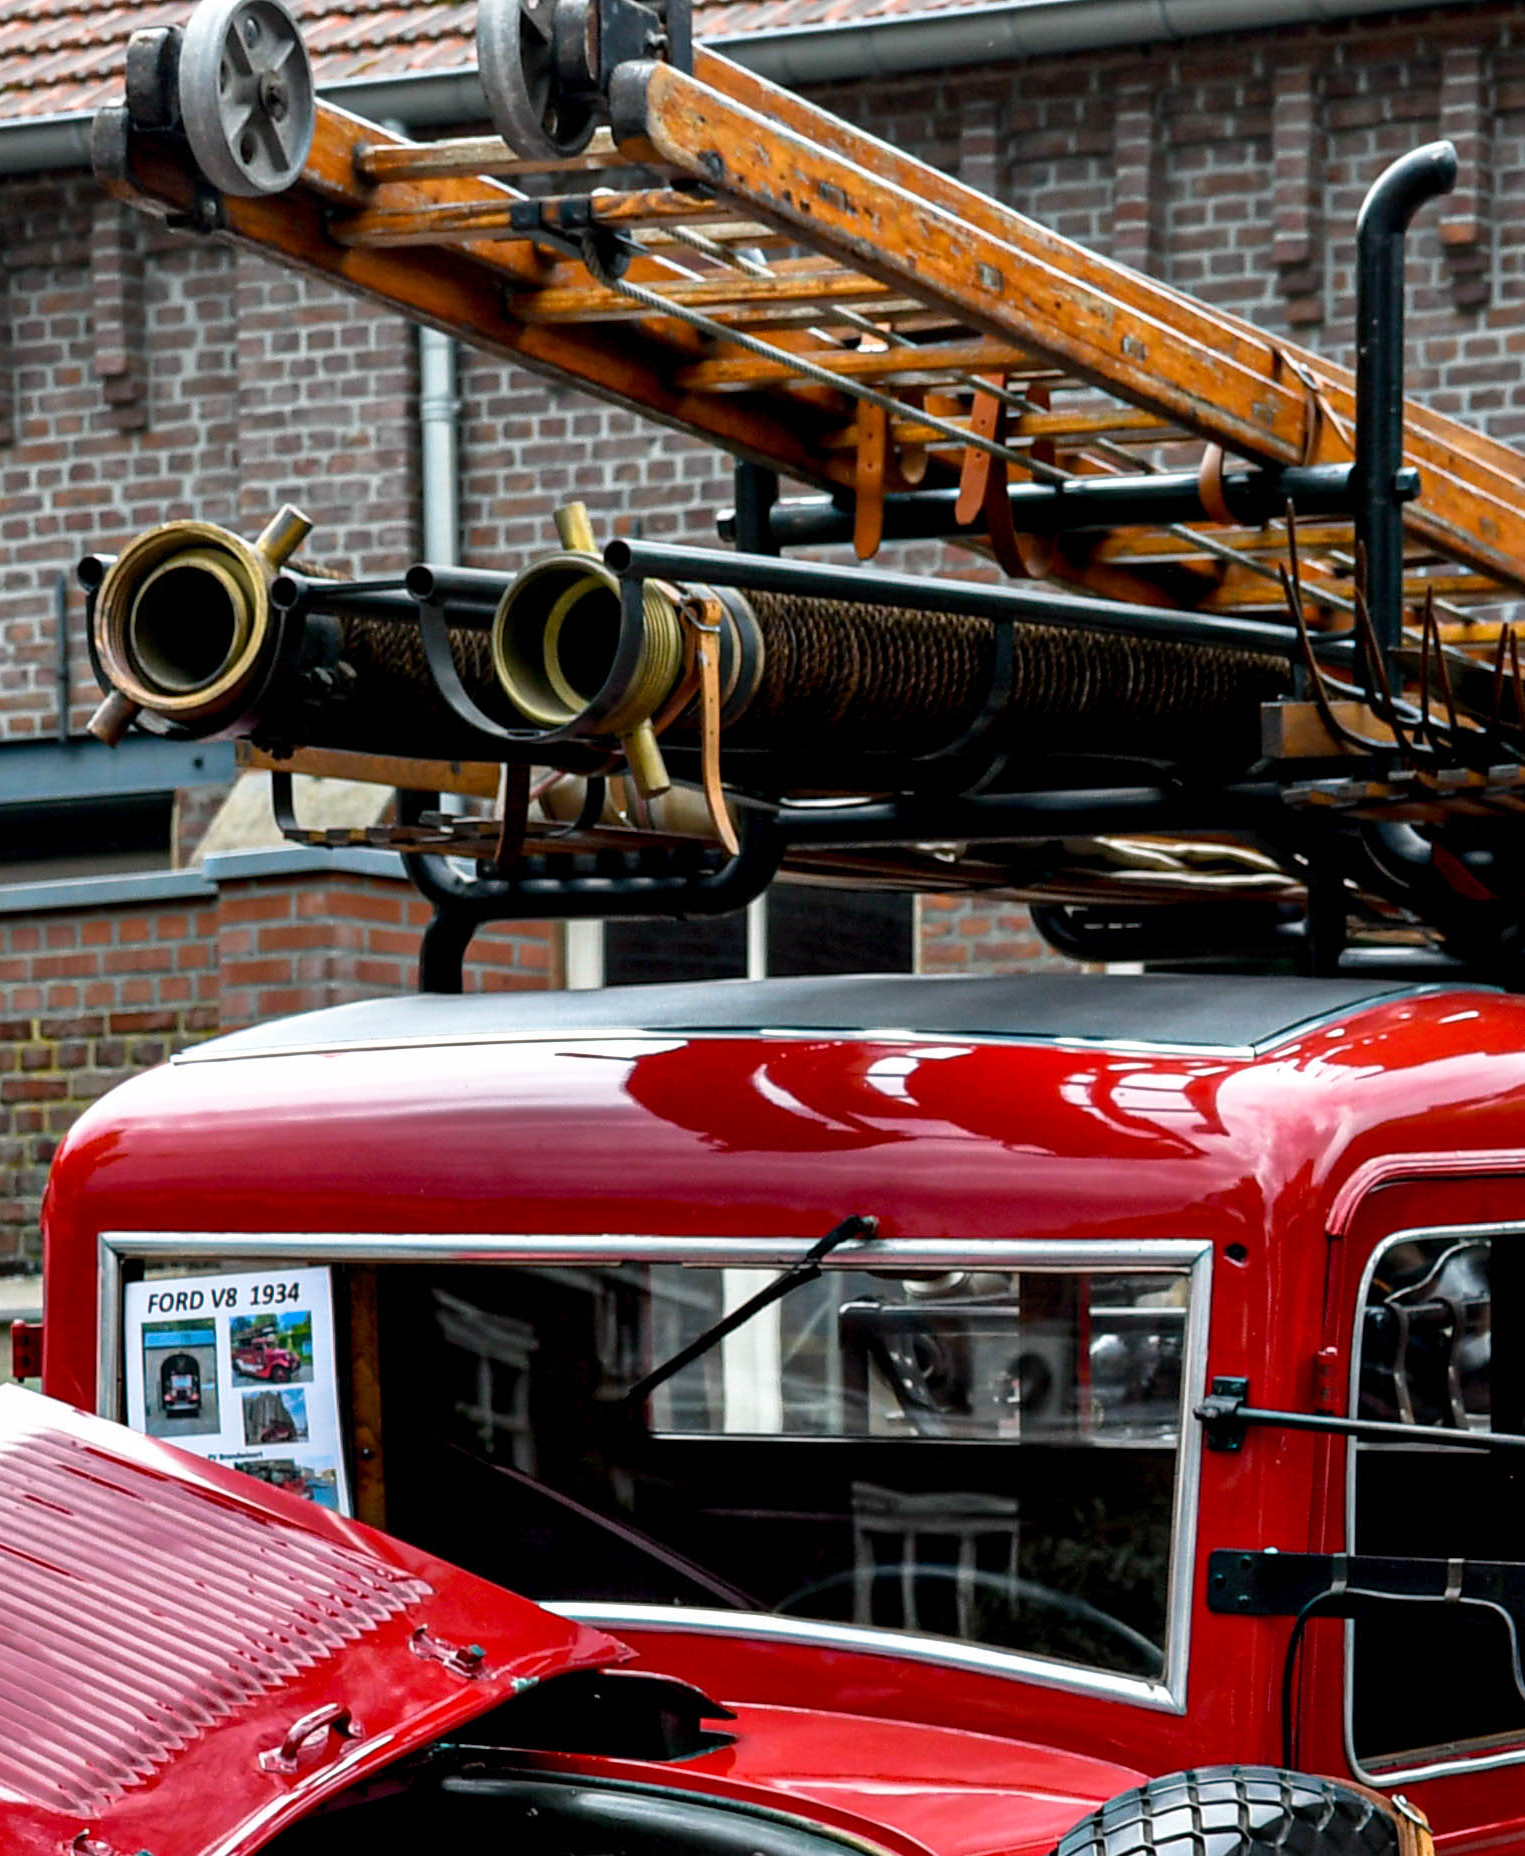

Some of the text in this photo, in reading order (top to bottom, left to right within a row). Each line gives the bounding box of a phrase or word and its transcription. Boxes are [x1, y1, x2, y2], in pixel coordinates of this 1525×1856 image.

[147, 1281, 300, 1314] FORD V8 1934
